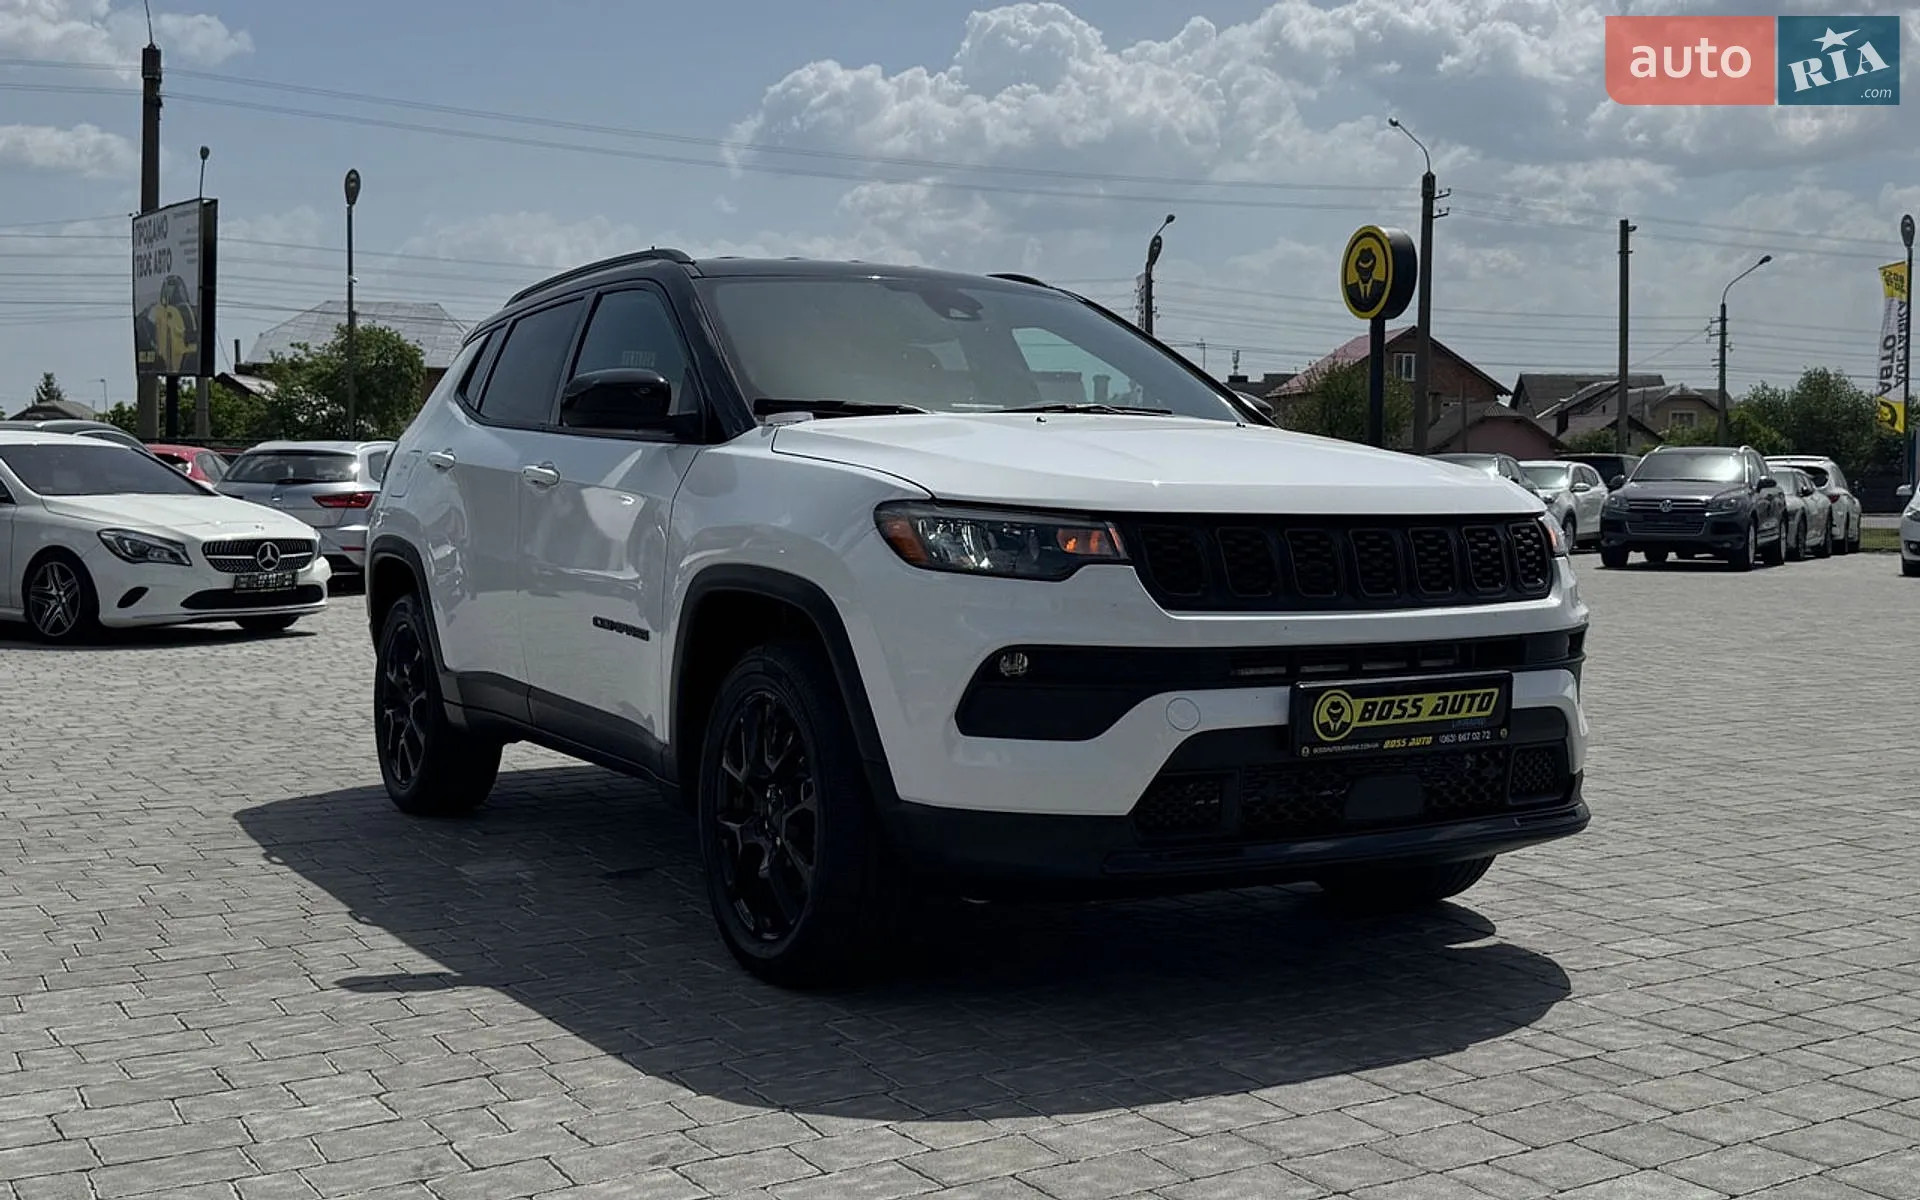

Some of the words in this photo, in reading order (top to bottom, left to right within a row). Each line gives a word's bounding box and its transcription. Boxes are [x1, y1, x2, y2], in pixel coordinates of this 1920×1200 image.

[1357, 698, 1424, 722] BOSS
[1428, 691, 1496, 717] AUTO
[1383, 739, 1407, 749] BOSS
